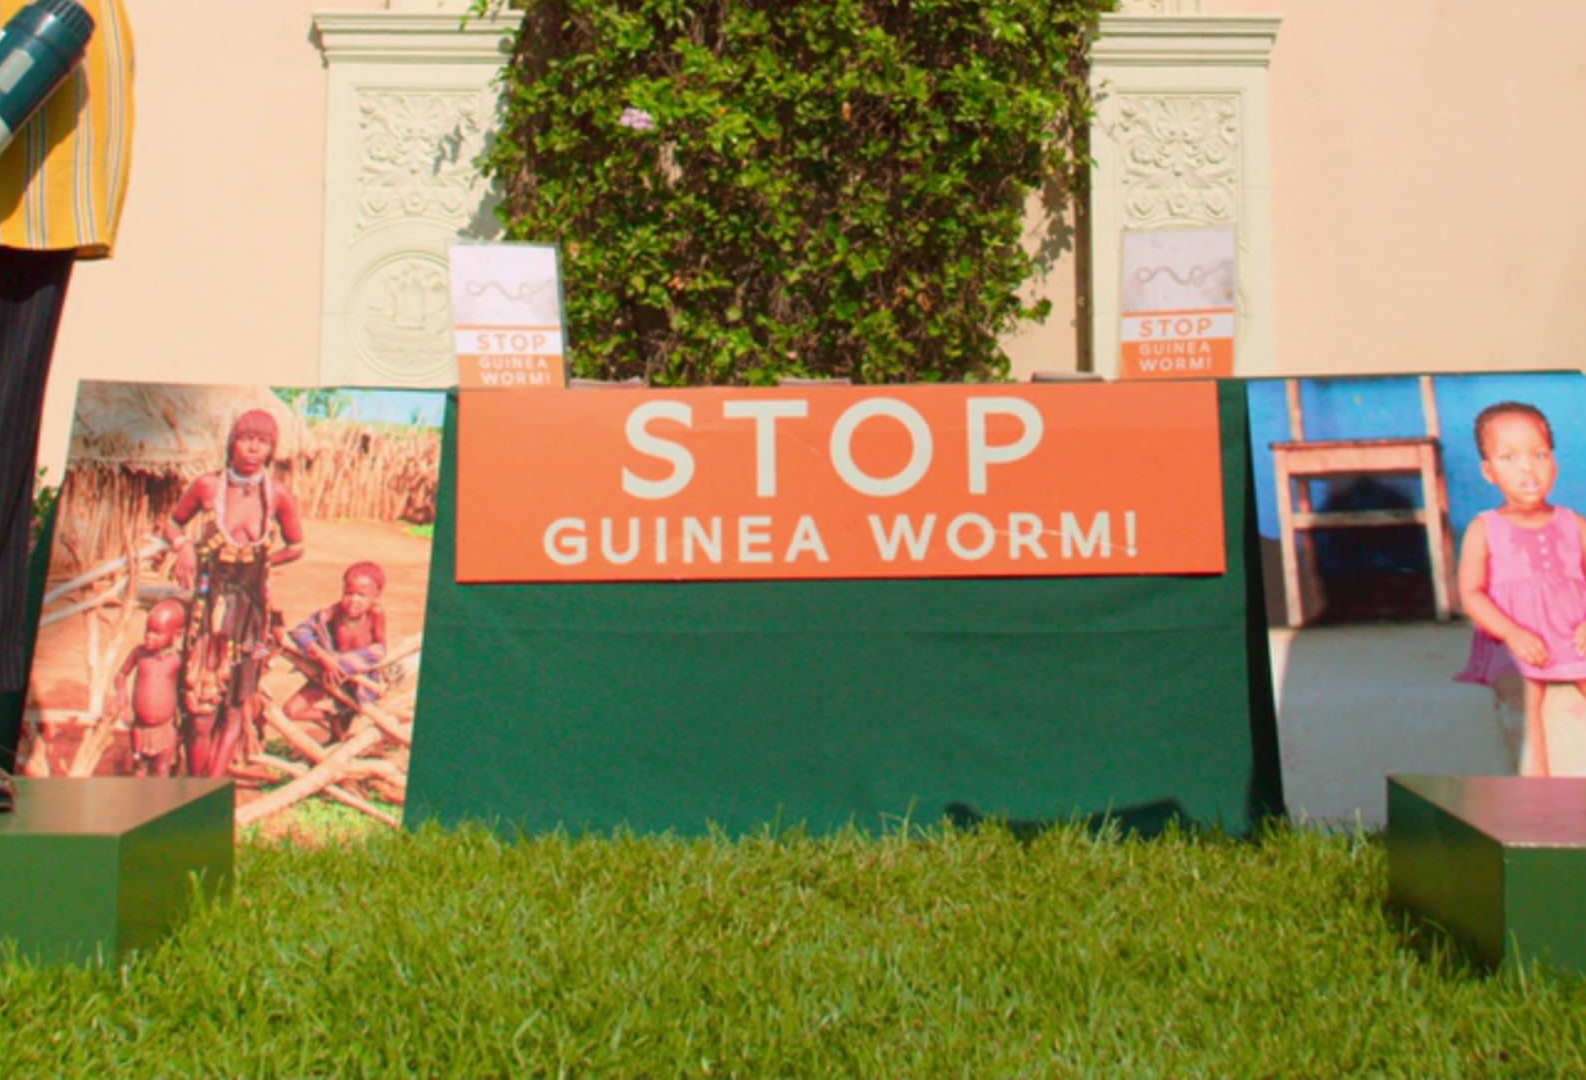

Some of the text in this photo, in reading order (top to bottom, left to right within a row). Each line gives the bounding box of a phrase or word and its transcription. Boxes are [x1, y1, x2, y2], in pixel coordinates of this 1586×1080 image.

[1140, 318, 1212, 337] STOP
[477, 334, 545, 350] STOP
[1139, 341, 1211, 355] GUINEA
[479, 357, 548, 369] GUINEA
[1139, 357, 1212, 371] WORM!
[480, 372, 551, 385] WORM!
[621, 396, 1046, 501] STOP
[543, 510, 1139, 566] GUINEA WORM!
